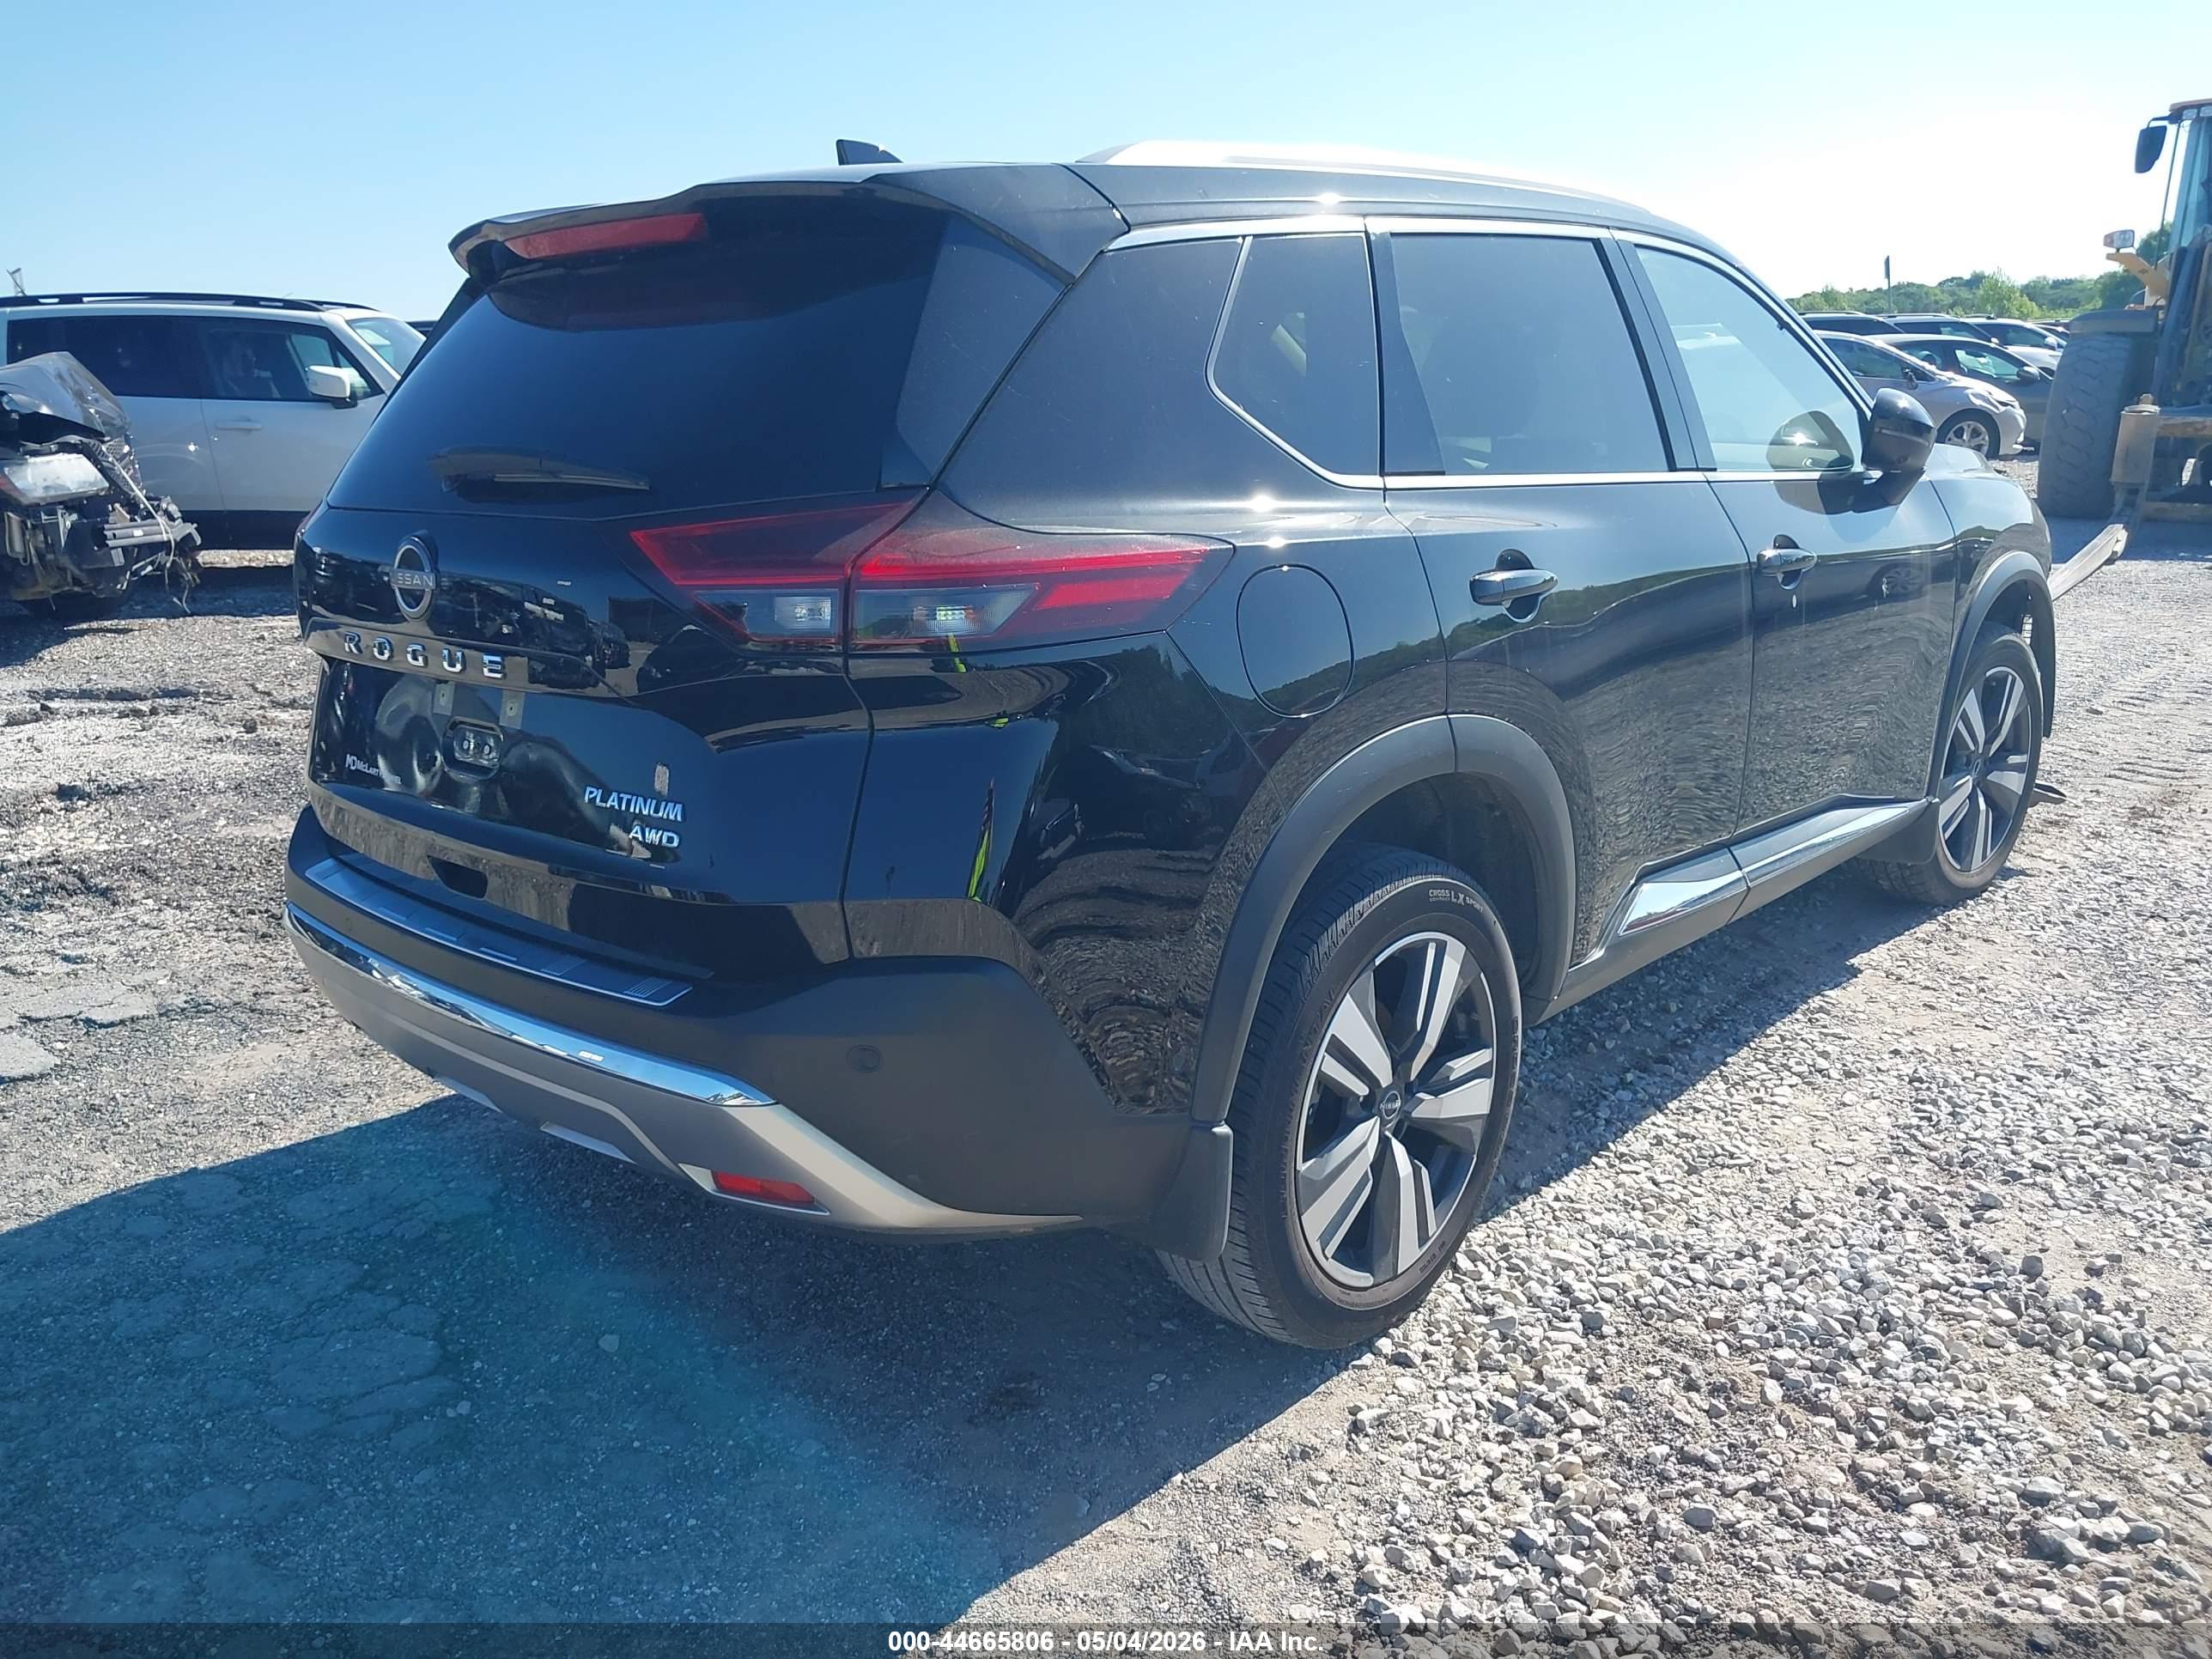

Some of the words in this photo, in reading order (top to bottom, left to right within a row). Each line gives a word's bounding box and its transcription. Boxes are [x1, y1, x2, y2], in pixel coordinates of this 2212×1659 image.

[392, 572, 434, 586] SSAN
[343, 631, 505, 678] ROGUE
[584, 786, 684, 822] PLATINUM
[629, 824, 680, 848] AWD
[1428, 889, 1450, 897] CROSS
[1450, 890, 1465, 906] LX
